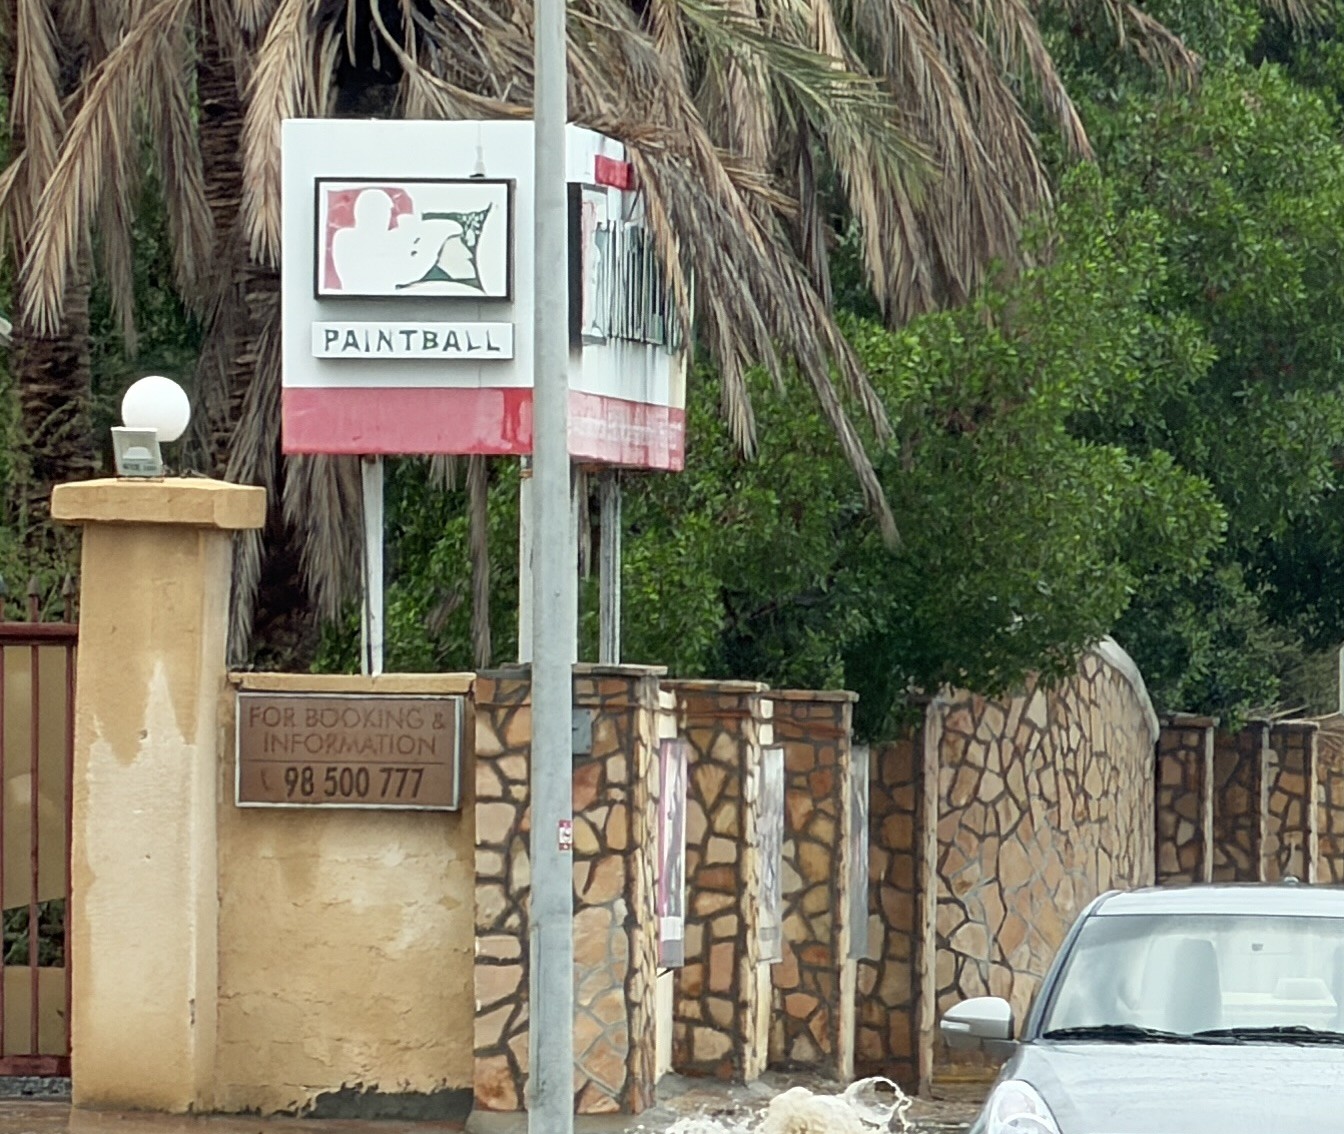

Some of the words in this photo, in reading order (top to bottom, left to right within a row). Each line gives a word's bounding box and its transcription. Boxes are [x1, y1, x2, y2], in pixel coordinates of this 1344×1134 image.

[325, 329, 501, 352] PAINTBALL
[249, 705, 296, 728] FOR
[305, 707, 424, 730] BOOKING
[432, 711, 446, 730] &
[263, 732, 437, 756] INFORMATION
[284, 766, 314, 797] 98
[324, 766, 370, 797] 500
[379, 767, 424, 798] 777
